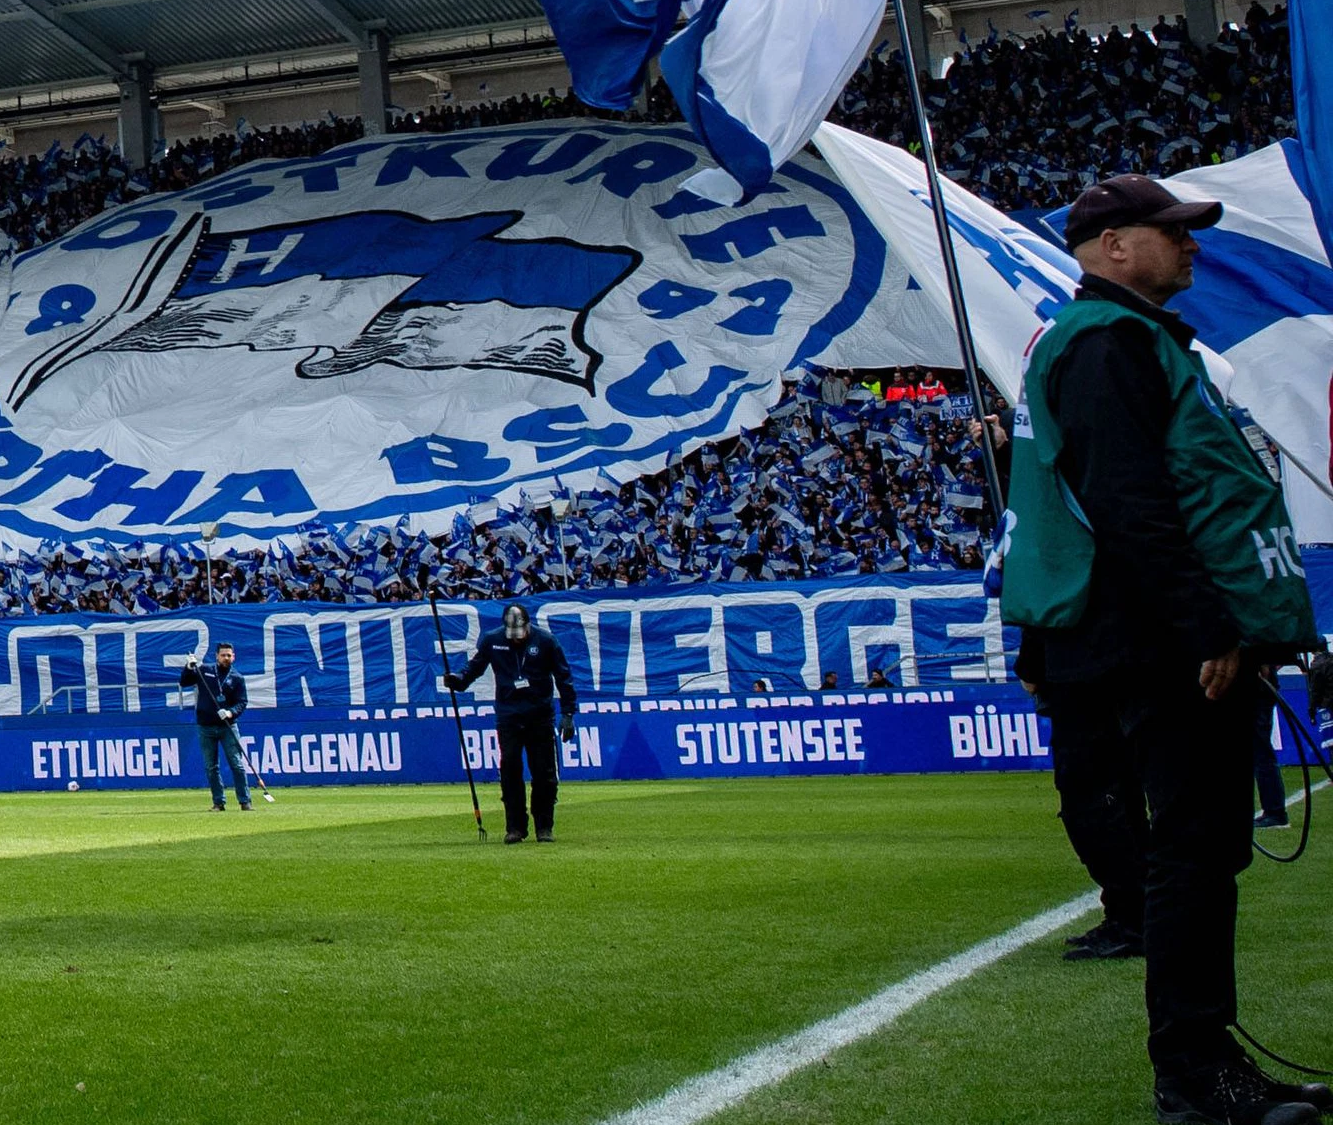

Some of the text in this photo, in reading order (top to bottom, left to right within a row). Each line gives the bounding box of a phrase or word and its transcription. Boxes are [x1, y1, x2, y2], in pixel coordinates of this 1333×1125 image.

[208, 232, 306, 284] H
[379, 340, 749, 485] BSC
[8, 619, 210, 715] DIE
[264, 603, 483, 707] NIE
[33, 737, 181, 778] ETTLINGEN
[242, 732, 402, 775] GAGGENAU
[676, 718, 865, 765] STUTENSEE
[949, 705, 1050, 759] BÜHL
